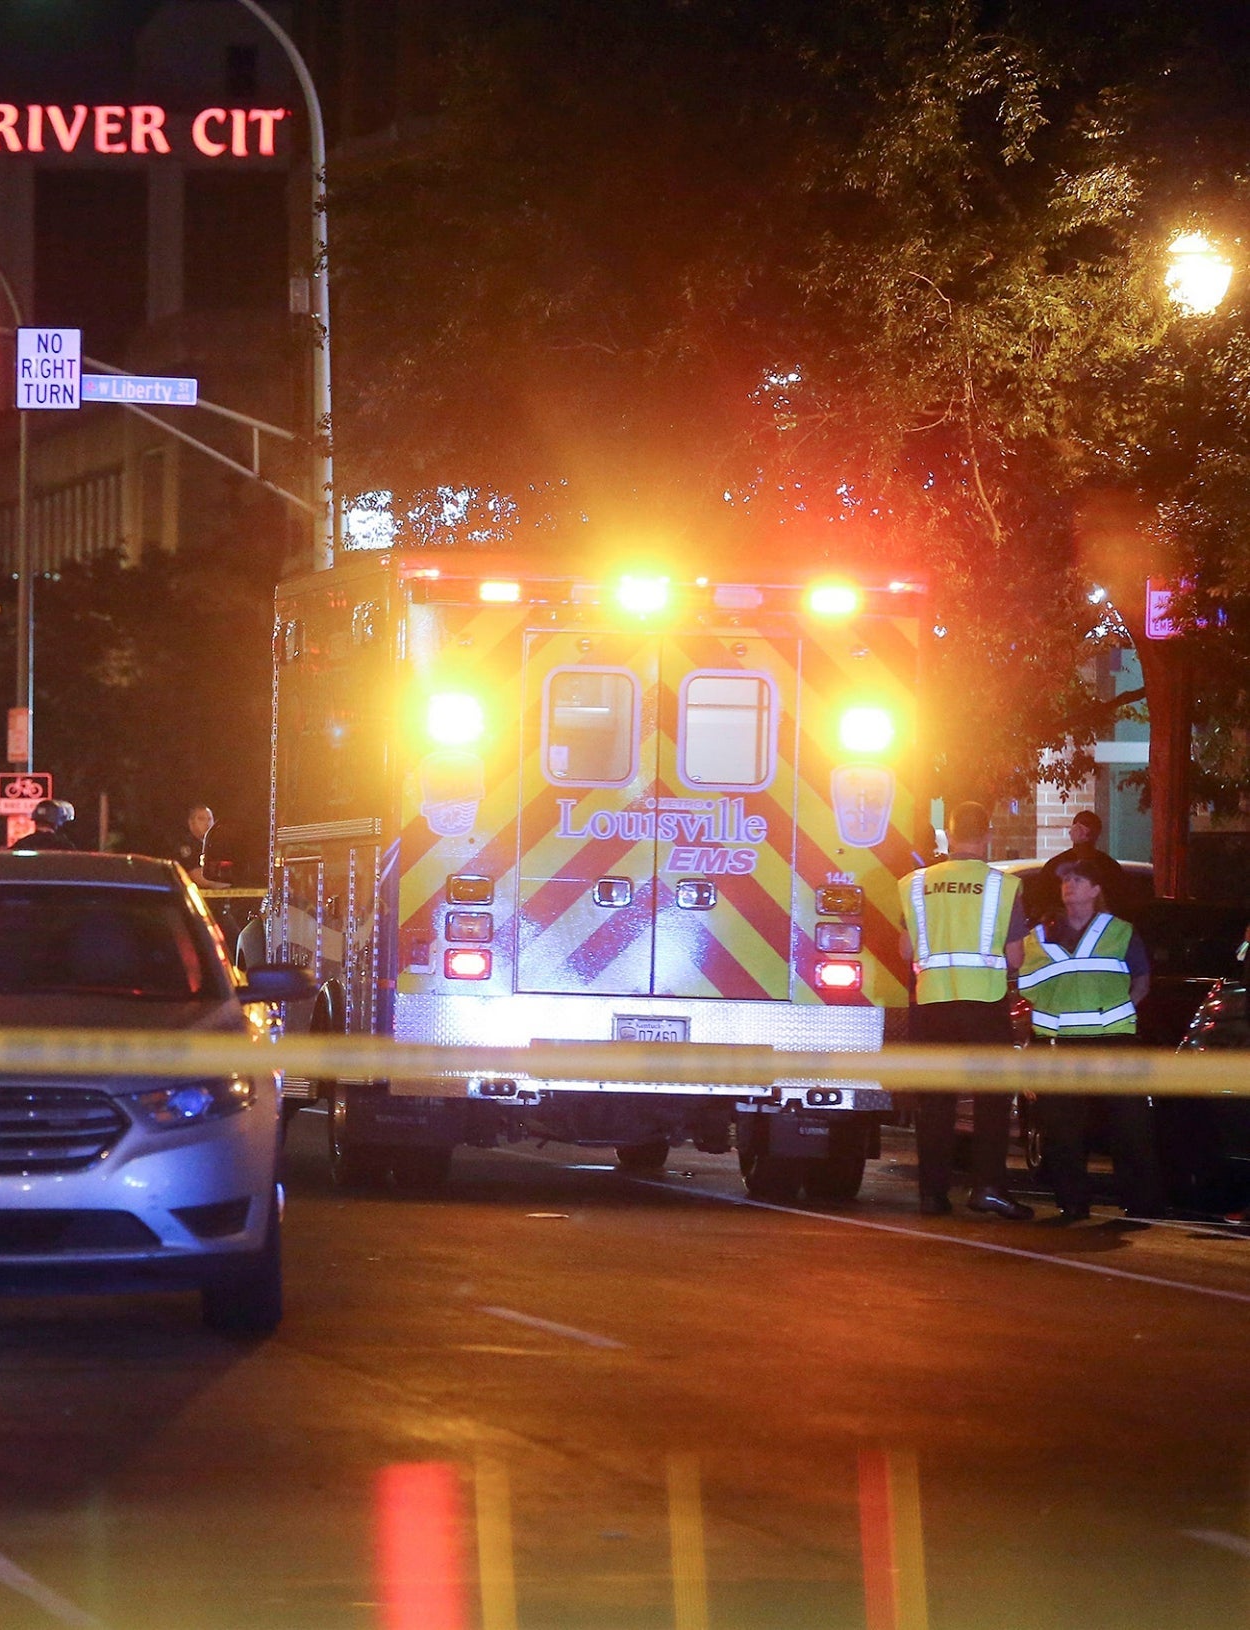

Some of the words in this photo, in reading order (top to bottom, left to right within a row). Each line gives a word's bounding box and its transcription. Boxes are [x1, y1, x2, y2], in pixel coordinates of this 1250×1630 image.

[191, 106, 288, 157] CIT
[37, 333, 63, 353] NO
[21, 358, 77, 379] RIGHT
[24, 383, 75, 404] TURN
[111, 379, 172, 402] Liberty
[555, 798, 768, 844] Louisville
[665, 846, 758, 875] EMS
[825, 871, 855, 885] 1442
[923, 881, 984, 895] LMEMS
